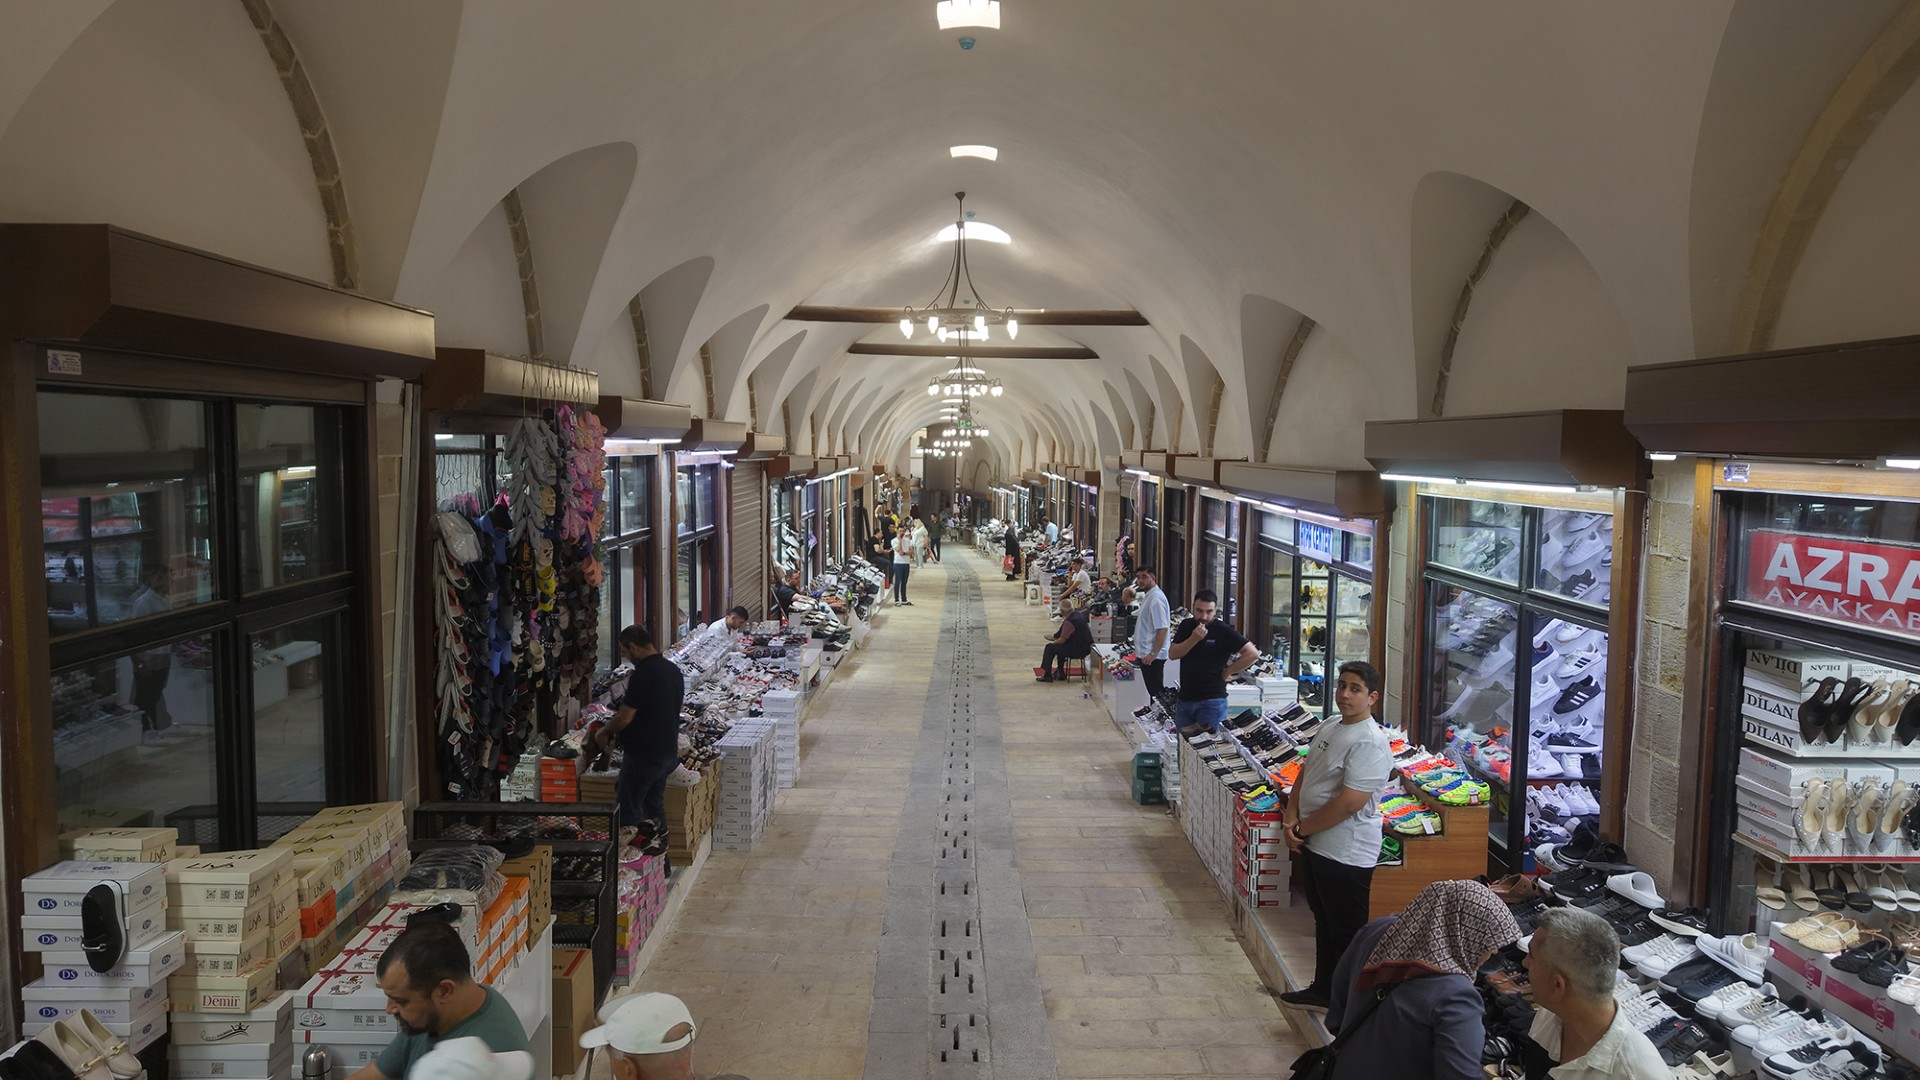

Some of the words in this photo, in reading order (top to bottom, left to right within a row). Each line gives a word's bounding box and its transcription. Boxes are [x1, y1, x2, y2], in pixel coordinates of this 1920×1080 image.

[1763, 542, 1920, 605] AZRA
[1750, 651, 1799, 675] DİLAN
[1746, 692, 1794, 720] DİLAN
[1745, 720, 1794, 749] DİLAN
[1757, 805, 1777, 818] Collection
[1758, 833, 1777, 847] Collection
[41, 900, 56, 908] DS
[41, 936, 57, 944] DS
[62, 971, 77, 979] DS
[112, 970, 135, 978] SHOES
[202, 995, 240, 1008] Demir
[41, 1008, 57, 1016] DS
